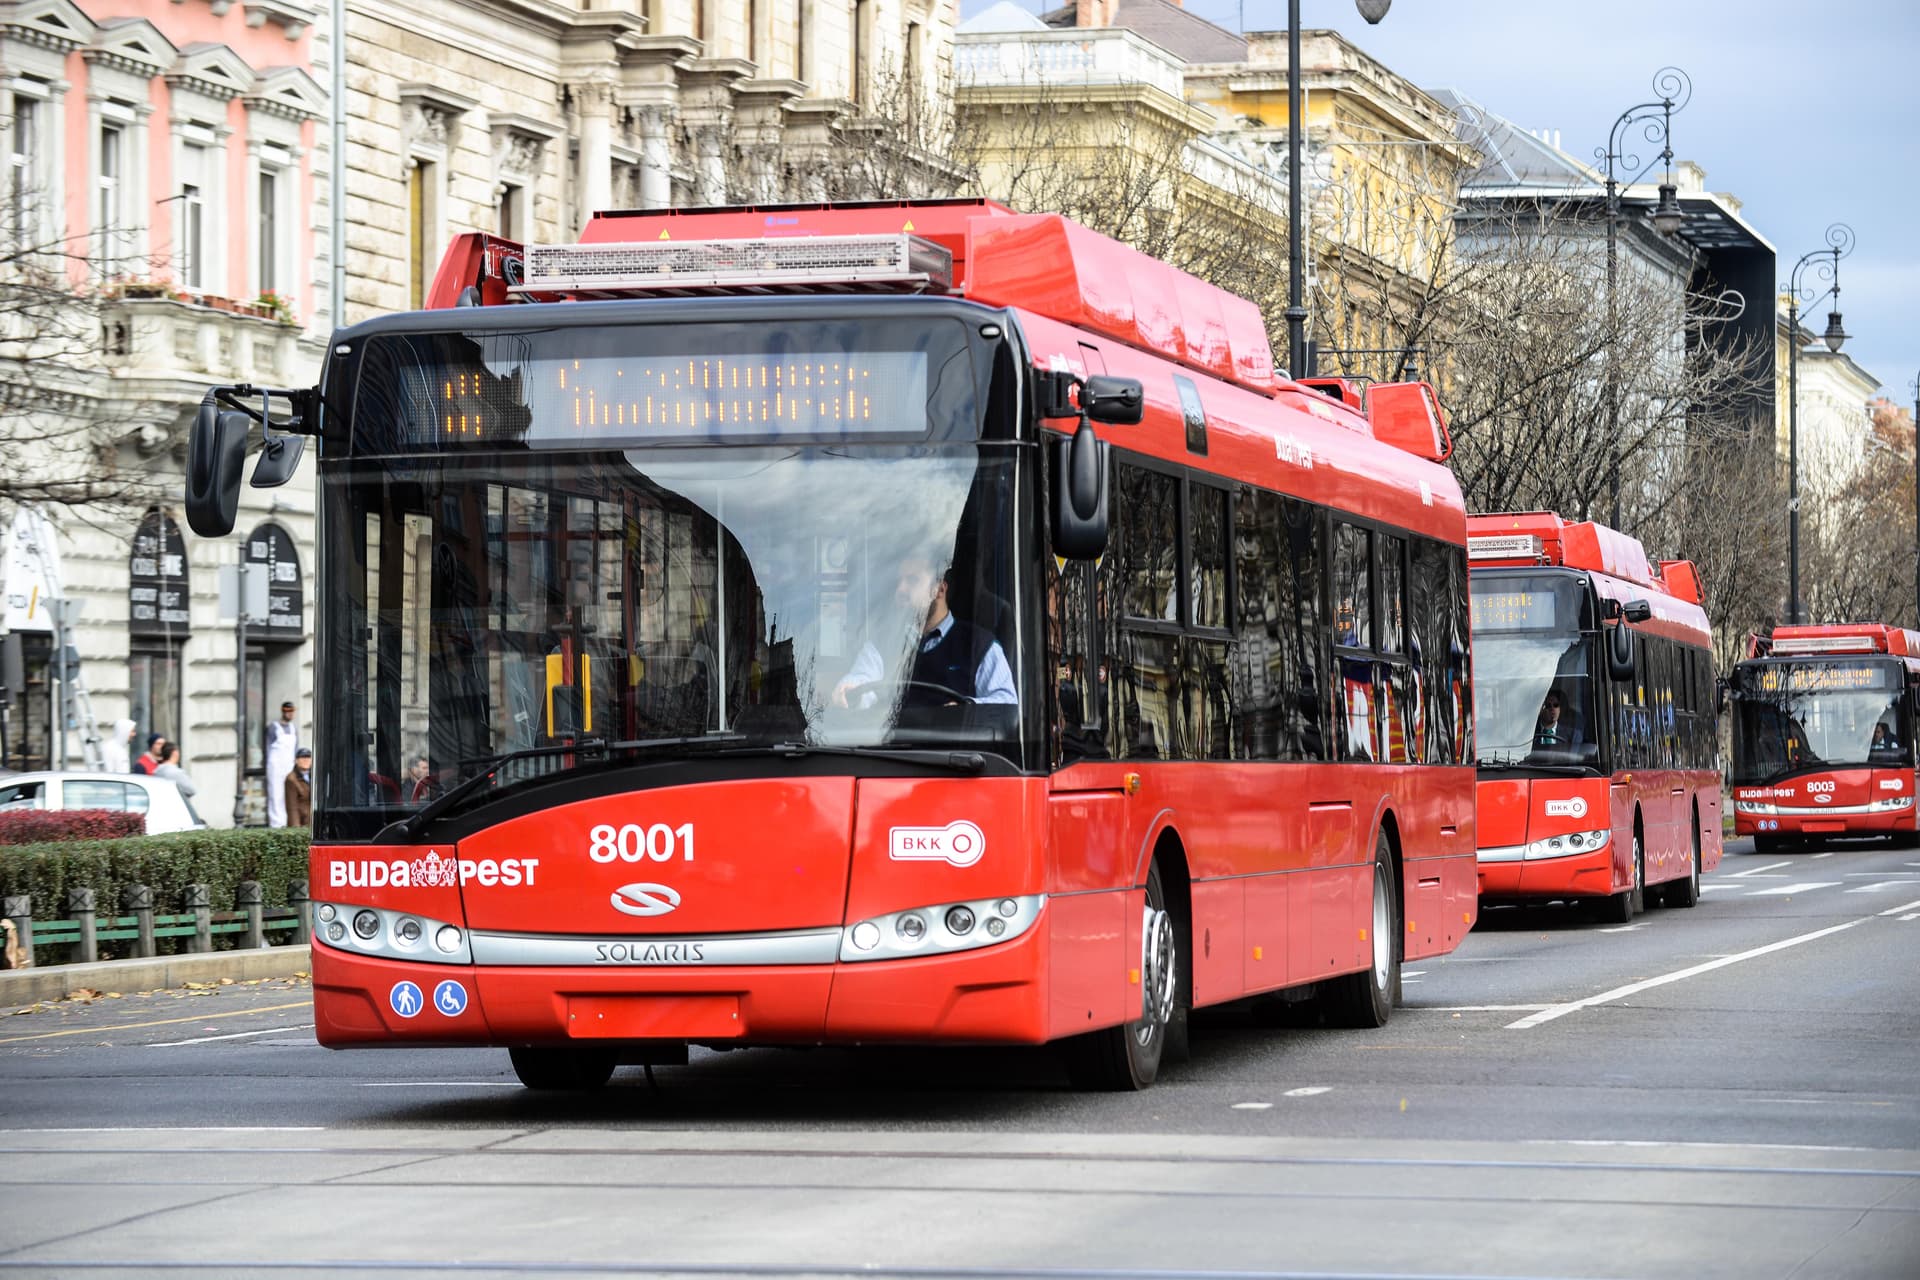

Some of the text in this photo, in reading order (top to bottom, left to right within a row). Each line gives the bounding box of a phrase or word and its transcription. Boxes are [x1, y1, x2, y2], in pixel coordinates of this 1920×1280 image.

[1806, 781, 1836, 794] 8003
[589, 822, 695, 864] 8001
[903, 837, 941, 850] BKK
[595, 943, 704, 962] SOLARIS
